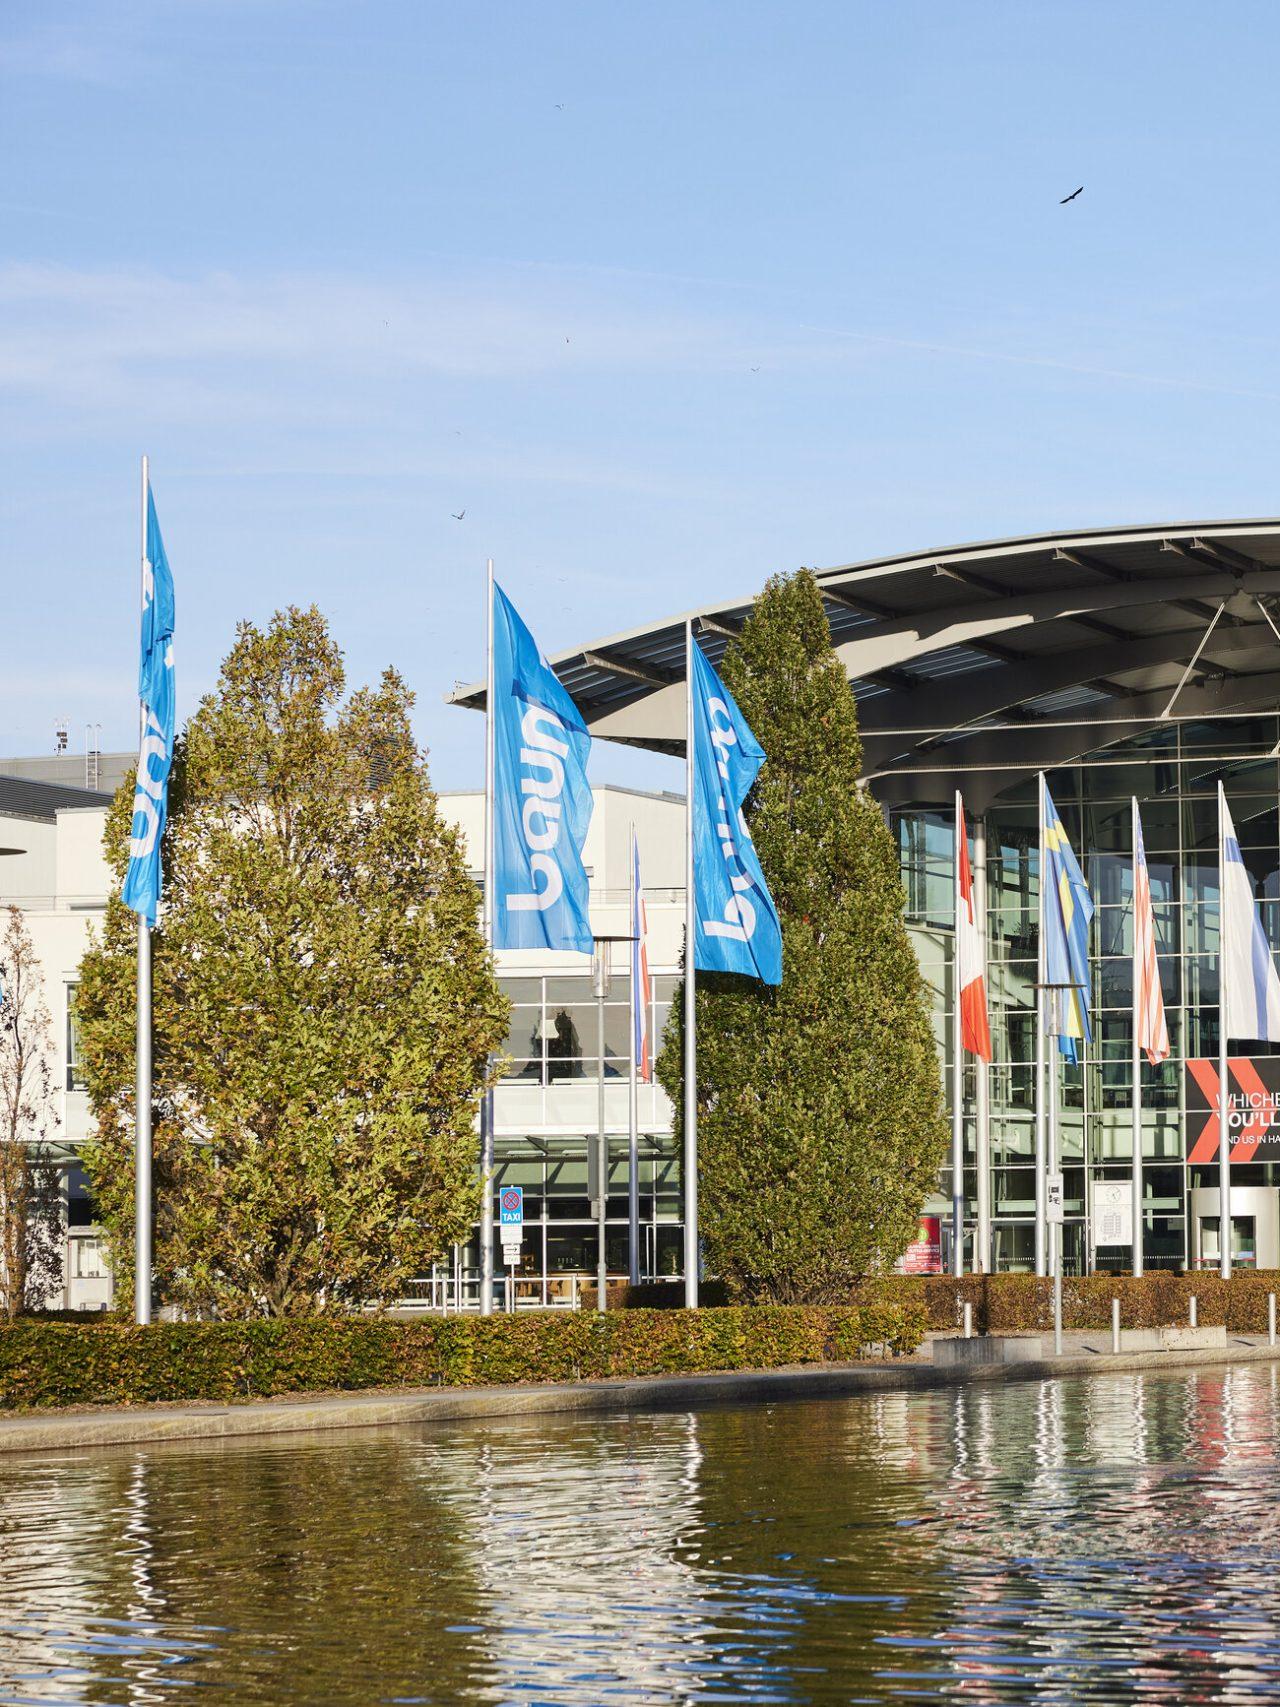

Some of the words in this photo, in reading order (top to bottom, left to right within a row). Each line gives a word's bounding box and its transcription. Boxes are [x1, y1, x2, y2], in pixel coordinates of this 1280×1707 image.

[1216, 1111, 1280, 1128] OU'LL
[1241, 1135, 1256, 1145] US
[1257, 1134, 1267, 1144] IN
[503, 1213, 520, 1221] TAXI
